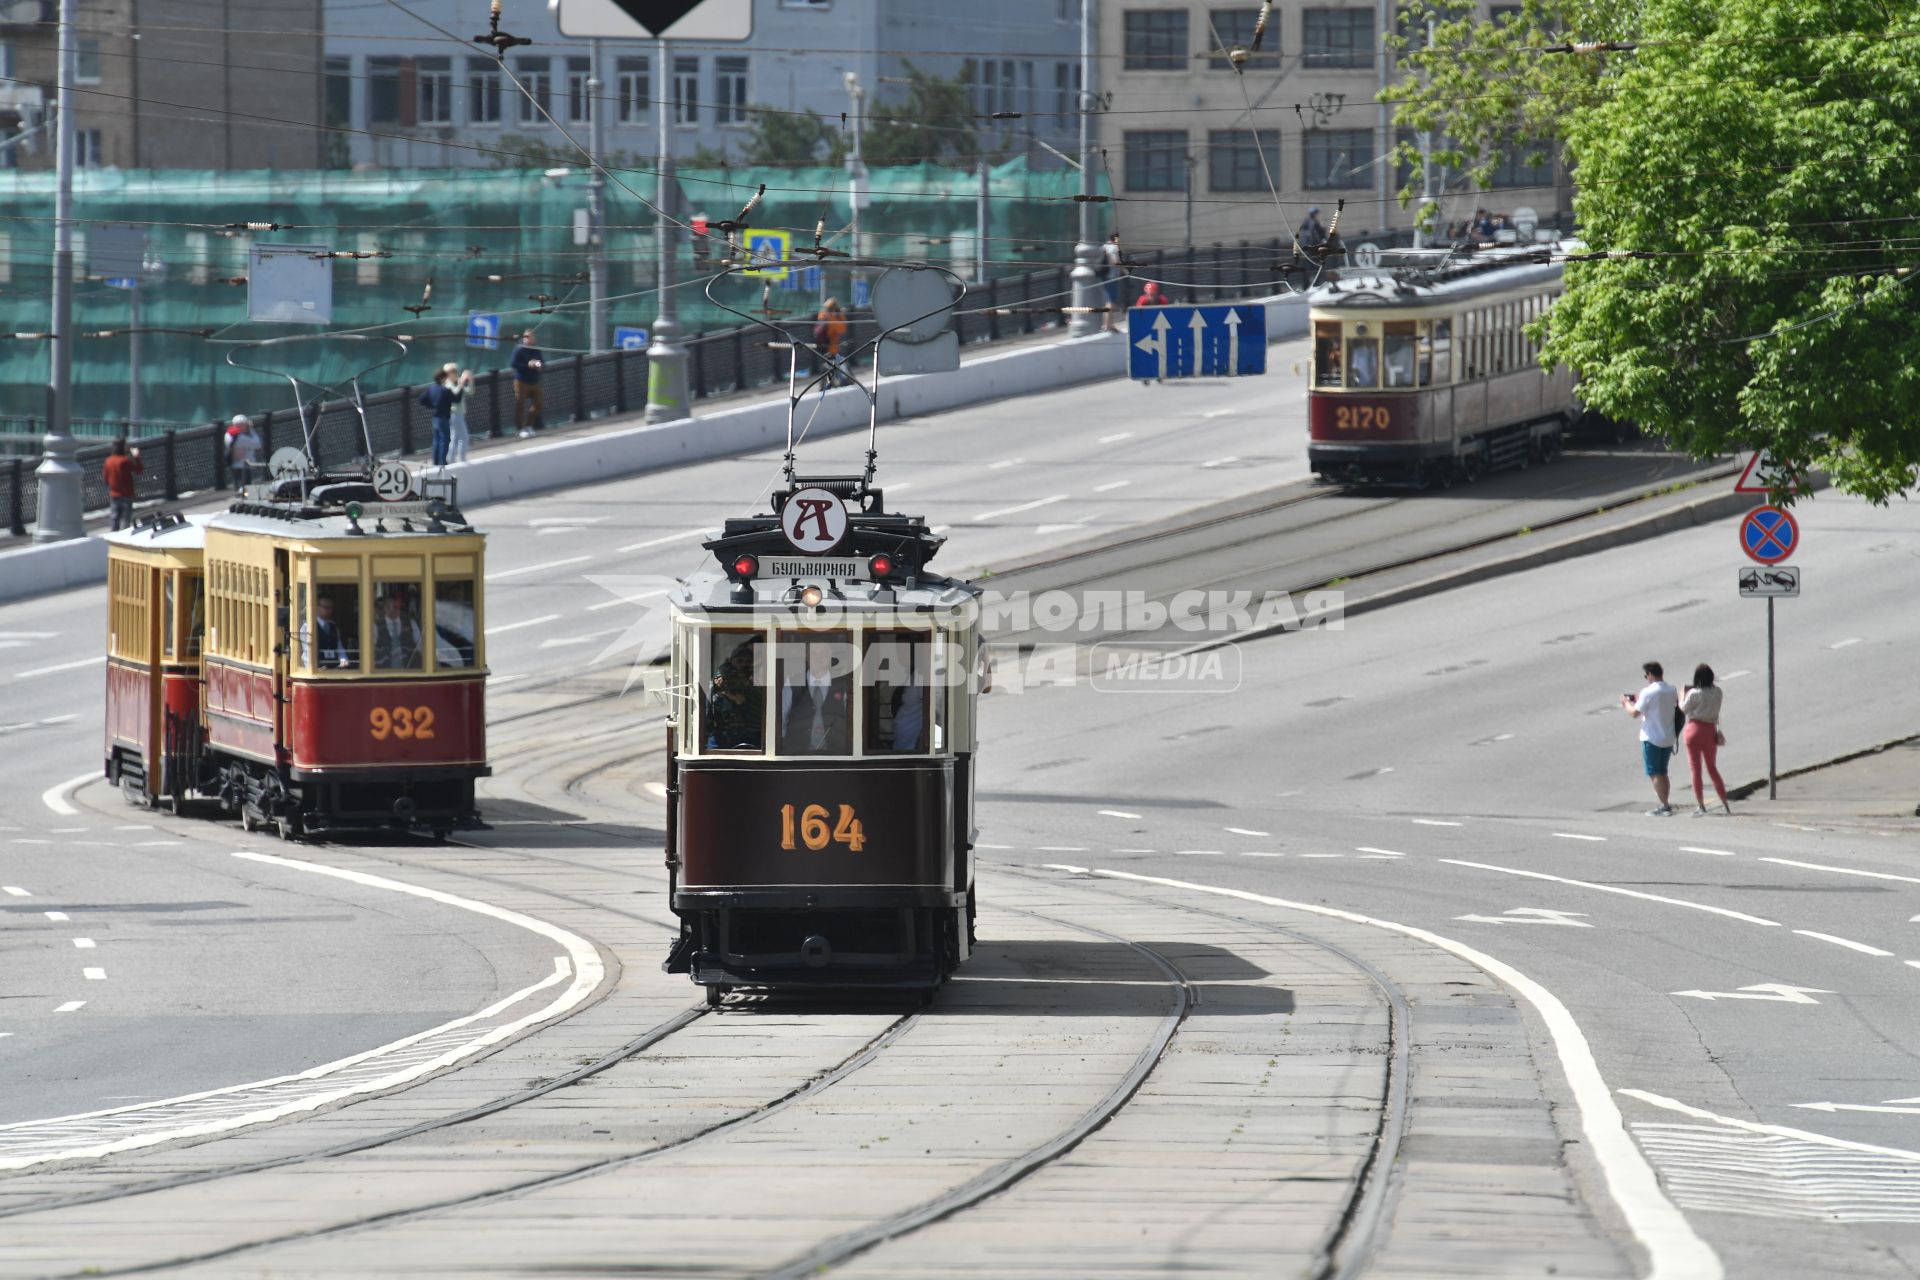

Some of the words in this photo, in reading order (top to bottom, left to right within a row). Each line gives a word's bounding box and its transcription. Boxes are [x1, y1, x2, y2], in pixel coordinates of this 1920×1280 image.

[1336, 405, 1390, 429] 2170
[378, 468, 408, 494] 29
[772, 562, 856, 576] БУЛЬВАРНАЯ
[370, 706, 434, 740] 932
[781, 803, 866, 851] 164
